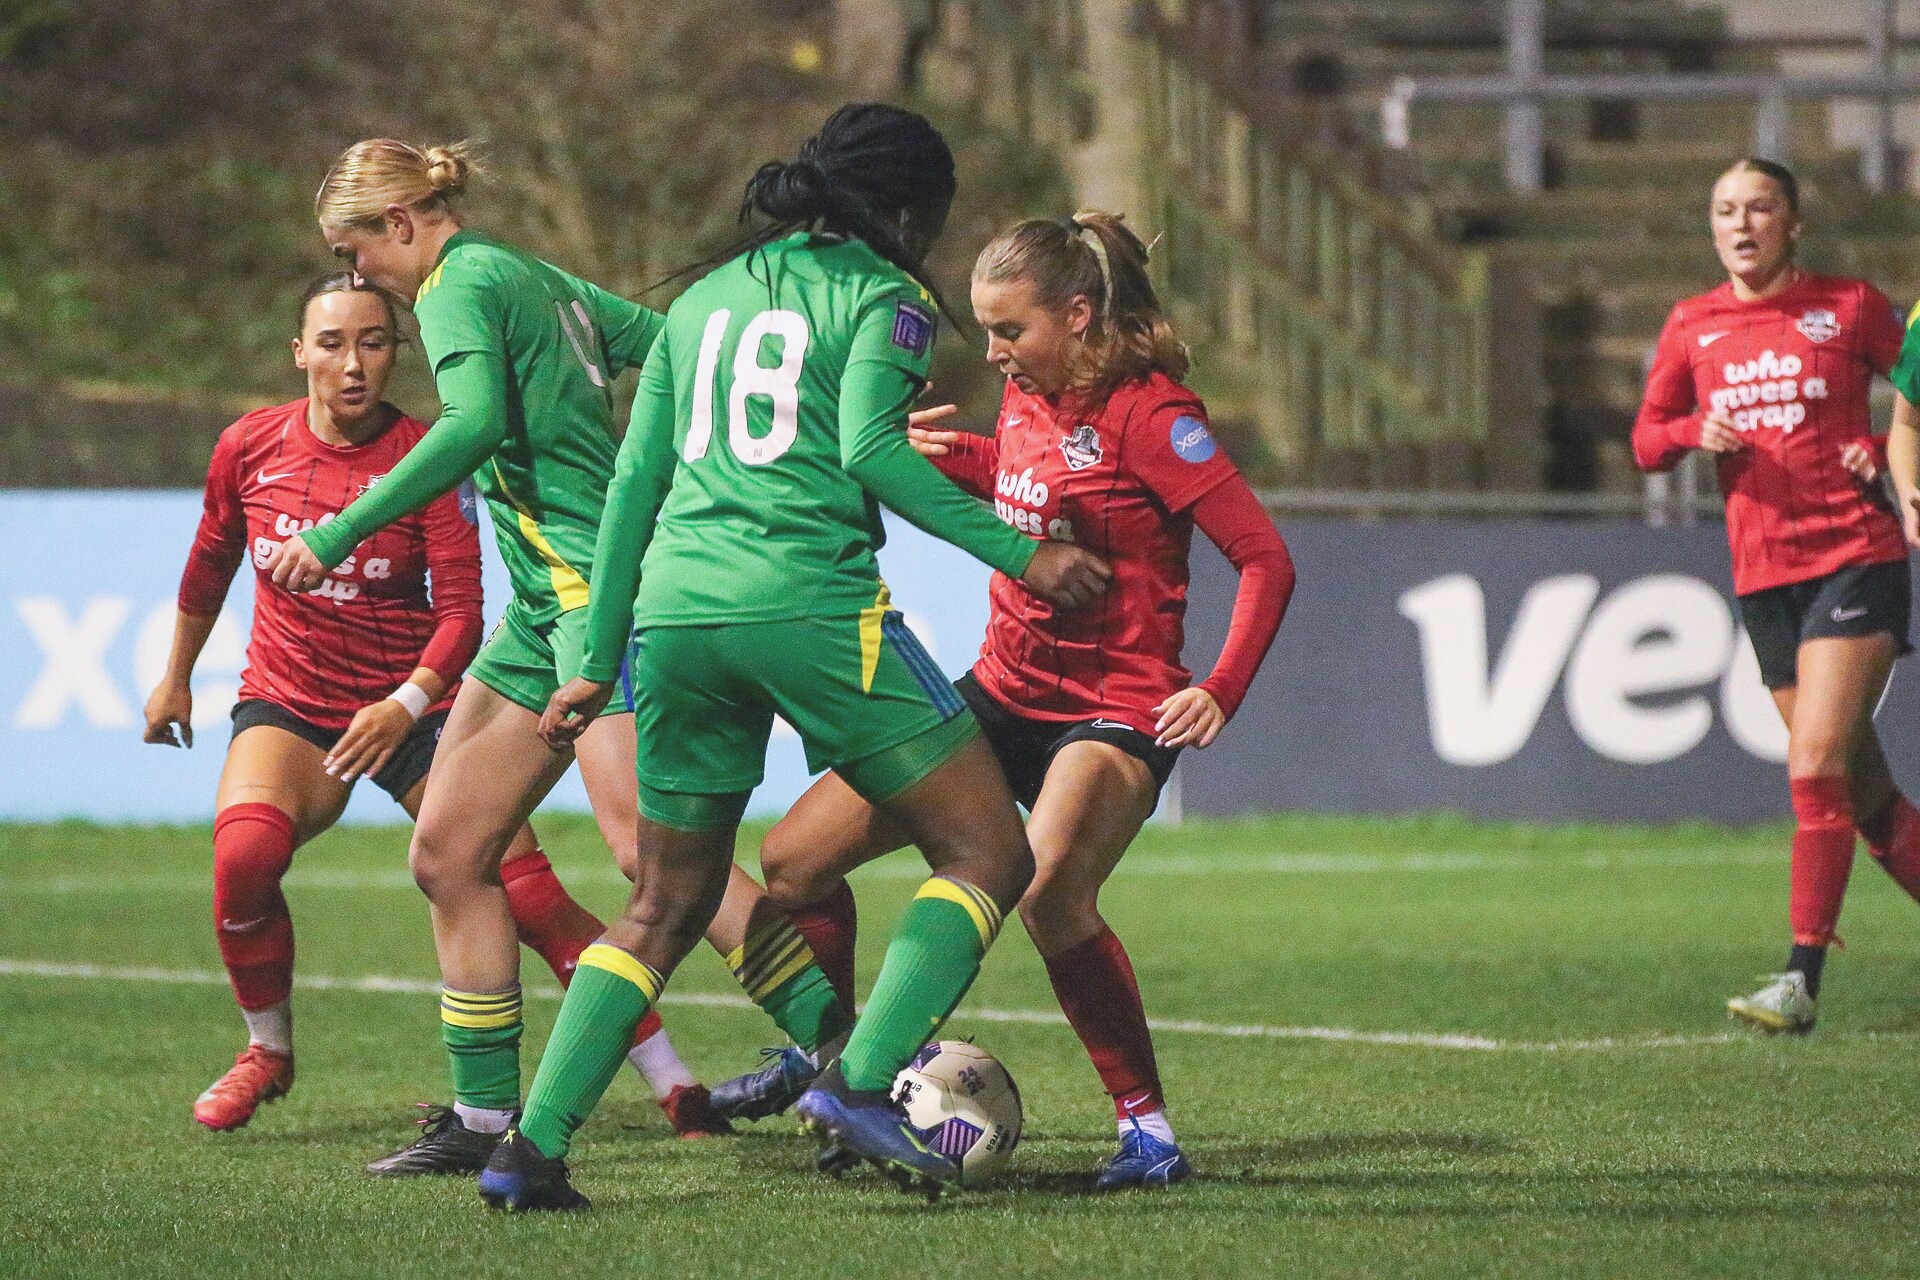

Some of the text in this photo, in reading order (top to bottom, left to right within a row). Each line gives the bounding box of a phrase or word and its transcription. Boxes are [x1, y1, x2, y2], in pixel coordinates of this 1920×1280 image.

[1723, 349, 1802, 385] who
[683, 308, 810, 466] 18
[1802, 376, 1828, 400] a
[1175, 426, 1208, 453] xero
[997, 467, 1049, 507] who
[1048, 518, 1075, 541] a
[362, 558, 392, 580] a
